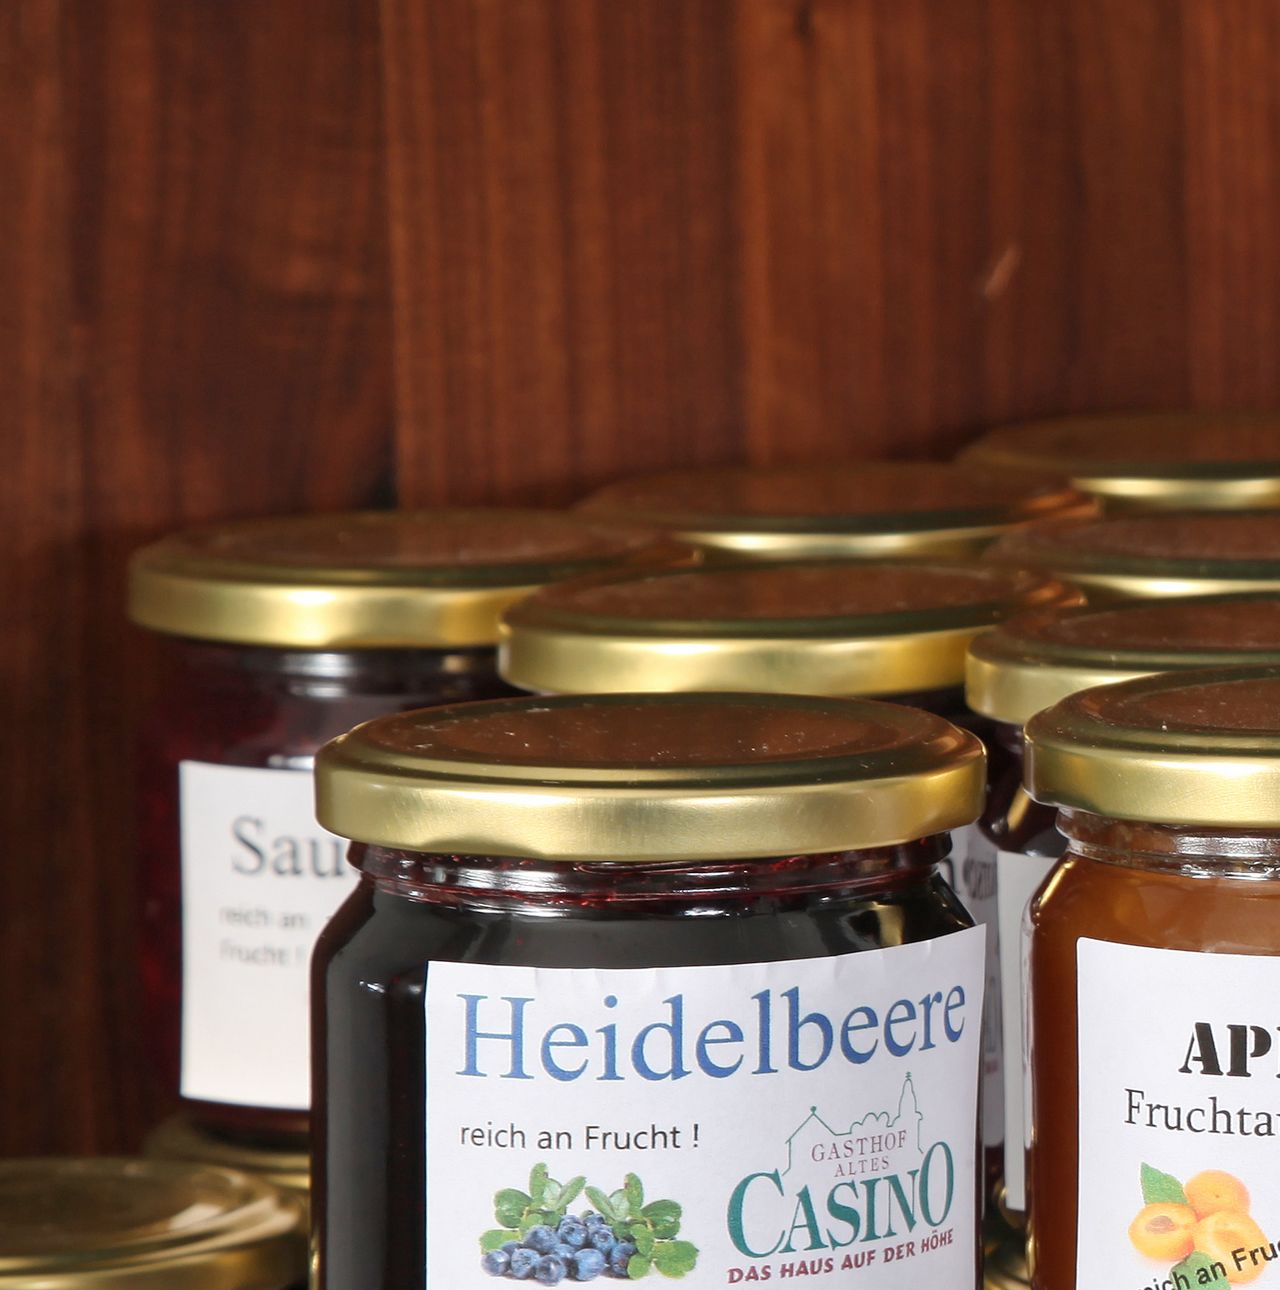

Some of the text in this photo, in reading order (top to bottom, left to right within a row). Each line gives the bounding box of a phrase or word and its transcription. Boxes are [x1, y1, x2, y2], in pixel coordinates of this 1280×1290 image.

[231, 815, 345, 878] Sau
[456, 985, 965, 1082] Heidelbeere
[460, 1121, 525, 1149] reich
[538, 1129, 573, 1151] an
[585, 1125, 680, 1151] Frucht
[811, 1130, 907, 1163] GASTHOF
[834, 1155, 890, 1178] ALTES
[726, 1141, 954, 1259] CASINO
[727, 1227, 954, 1284] DAS HAUS AUF DER HÖHE
[1195, 1261, 1227, 1286] an
